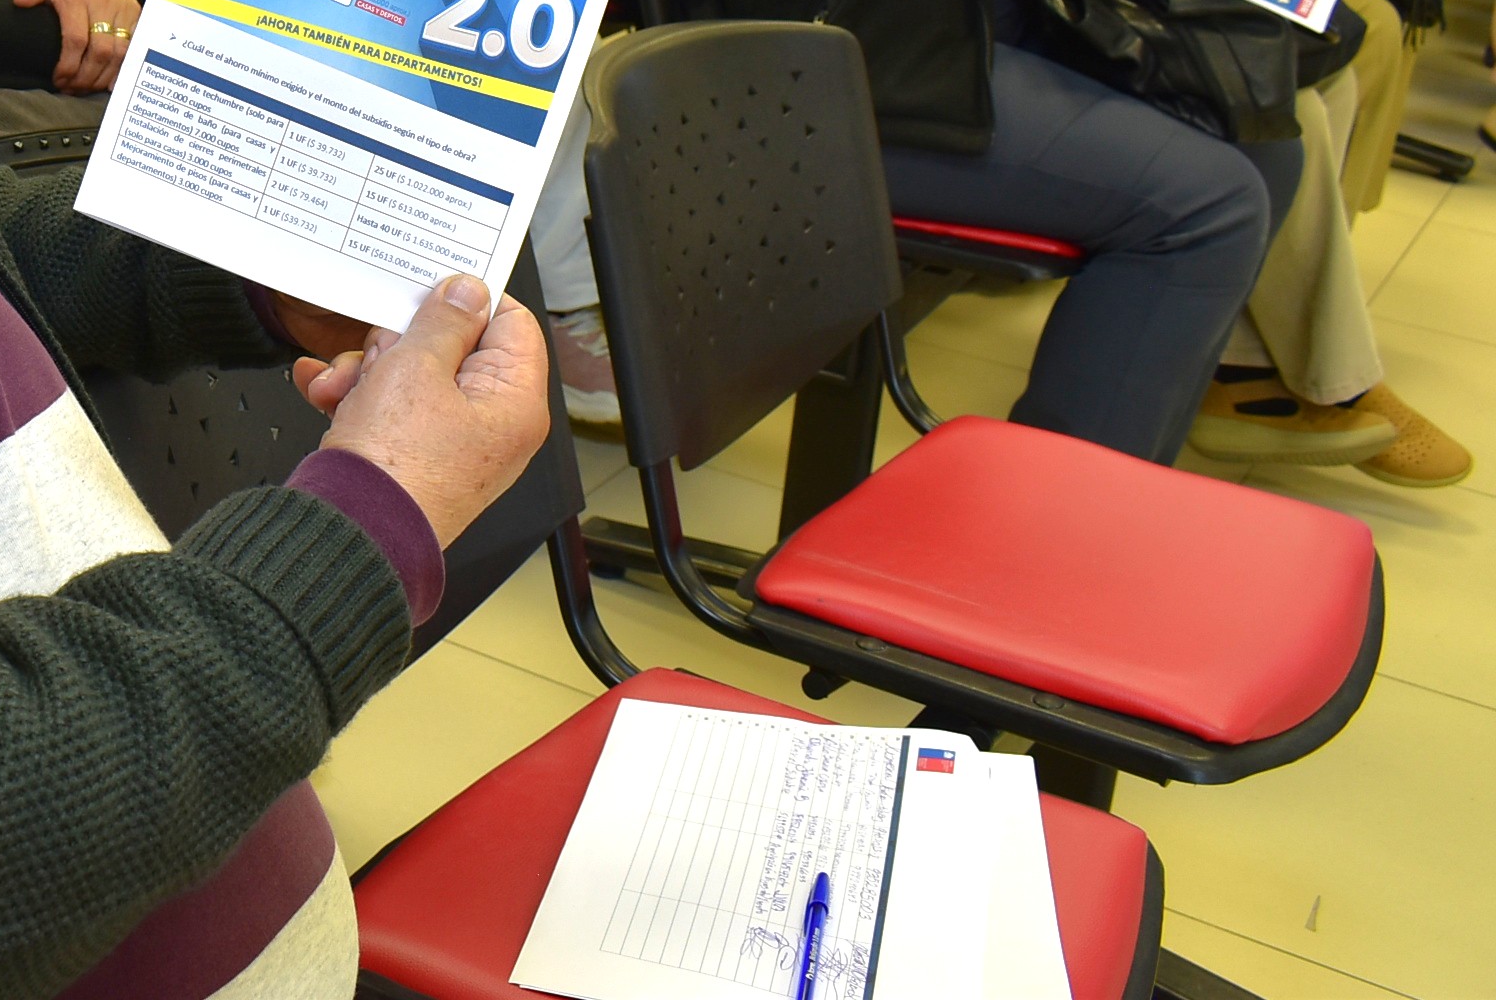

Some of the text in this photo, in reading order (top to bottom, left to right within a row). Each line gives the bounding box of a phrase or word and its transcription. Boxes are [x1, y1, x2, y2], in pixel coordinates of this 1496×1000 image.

[356, 0, 375, 11] CASAS
[378, 9, 403, 24] DEPTOS.
[255, 14, 483, 87] ¡AHORA TAMBIÉN PARA DEPARTAMENTOS!
[140, 78, 212, 114] casas) 7.000 cupos
[144, 66, 284, 129] Reparación de techumbre (solo para
[181, 38, 477, 163] ¿Cuál es el ahorro mínimo exigido y el monto del subsidio según el tipo de obra?
[127, 115, 267, 178] Instalación de cierres perimetrales
[131, 103, 240, 153] departamentos) 7.000 cupos
[135, 91, 276, 154] Reparación de baño (para casas y
[288, 131, 346, 160] 1 UF ($ 39.732)
[115, 151, 223, 202] departamentos) 3.000 cupos
[119, 139, 258, 203] Mejoramiento de pisos (para casas y
[123, 127, 233, 178] (solo para casas) 3.000 cupos
[279, 156, 337, 185] 1 UF ($ 39.732)
[270, 180, 328, 209] 2 UF ($ 79.464)
[374, 165, 472, 211] 25 UF ($ 1.022.000 aprox.)
[262, 205, 317, 234] 1 UF ($39.732)
[356, 214, 478, 269] Hasta 40 UF ($ 1.635.000 aprox.)
[347, 239, 437, 282] 15 UF ($613.000 aprox.)
